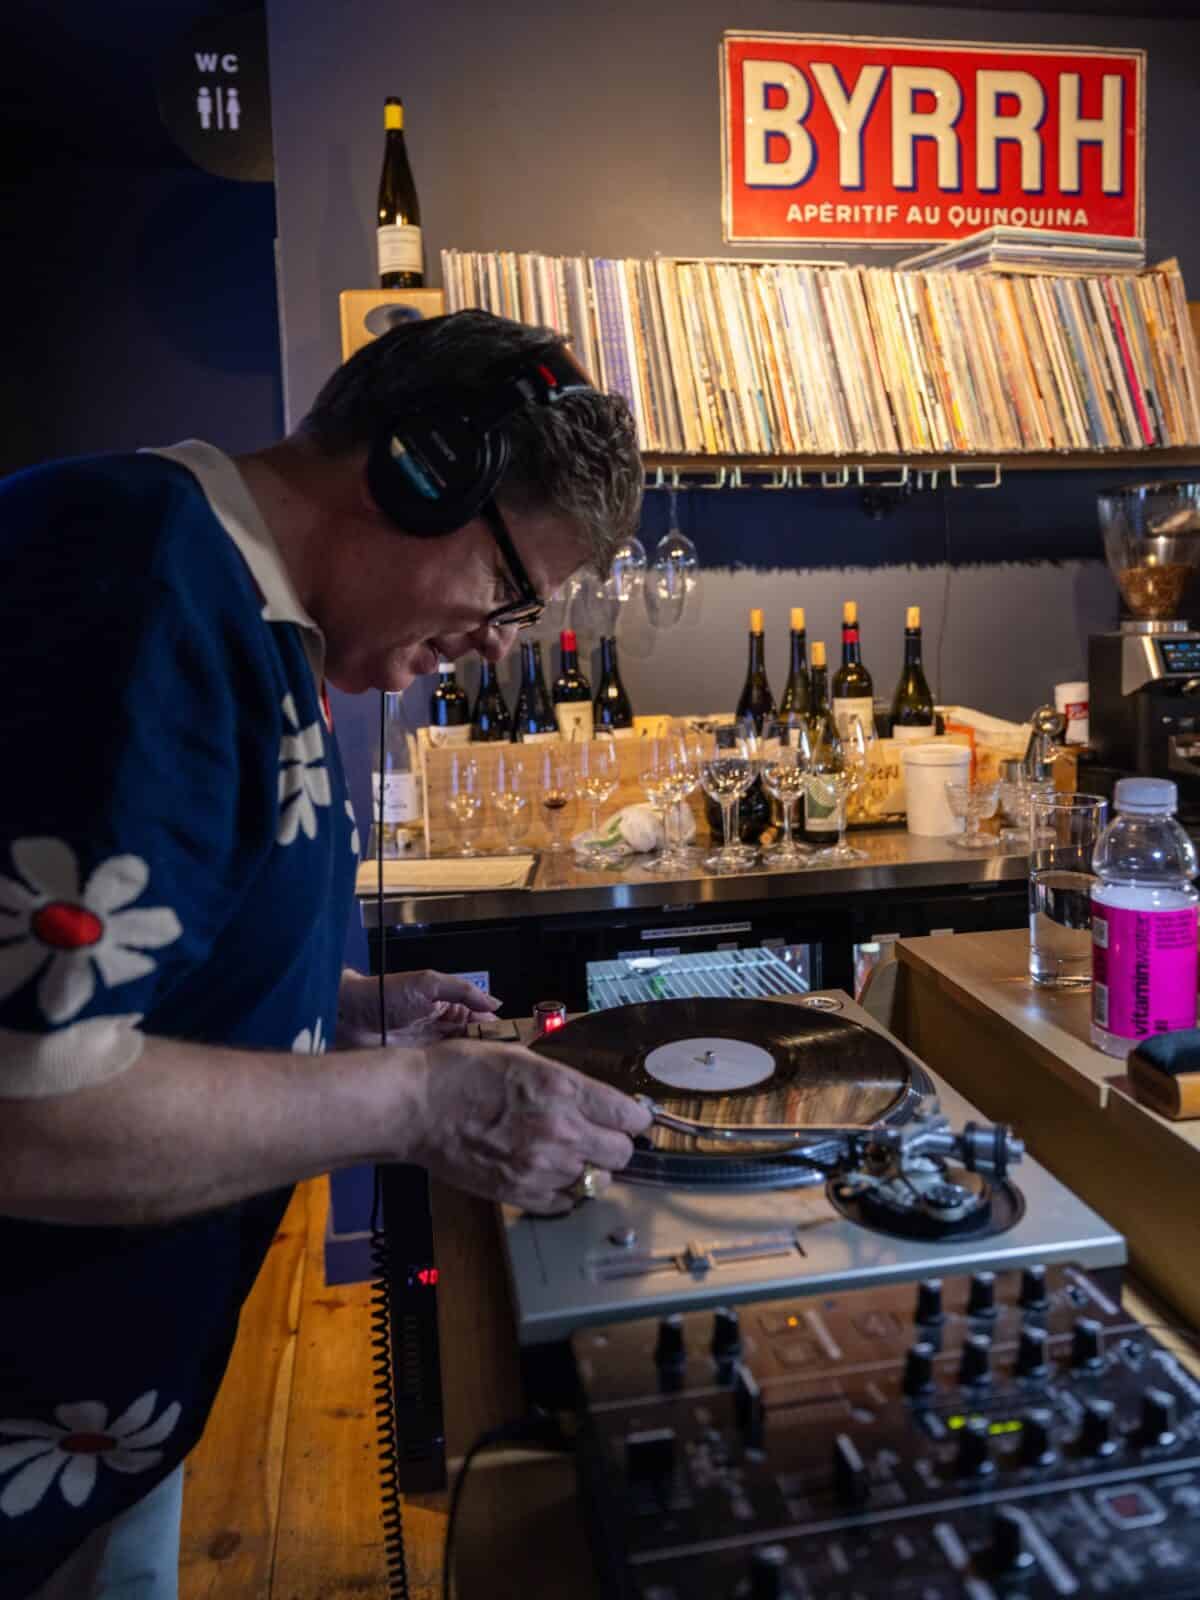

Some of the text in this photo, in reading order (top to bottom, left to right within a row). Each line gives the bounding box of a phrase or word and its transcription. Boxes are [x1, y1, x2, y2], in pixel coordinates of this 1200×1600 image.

[195, 54, 239, 73] WC
[742, 59, 1124, 197] BYRRH
[786, 202, 1088, 227] APÉRITIF AU QUINQUINA
